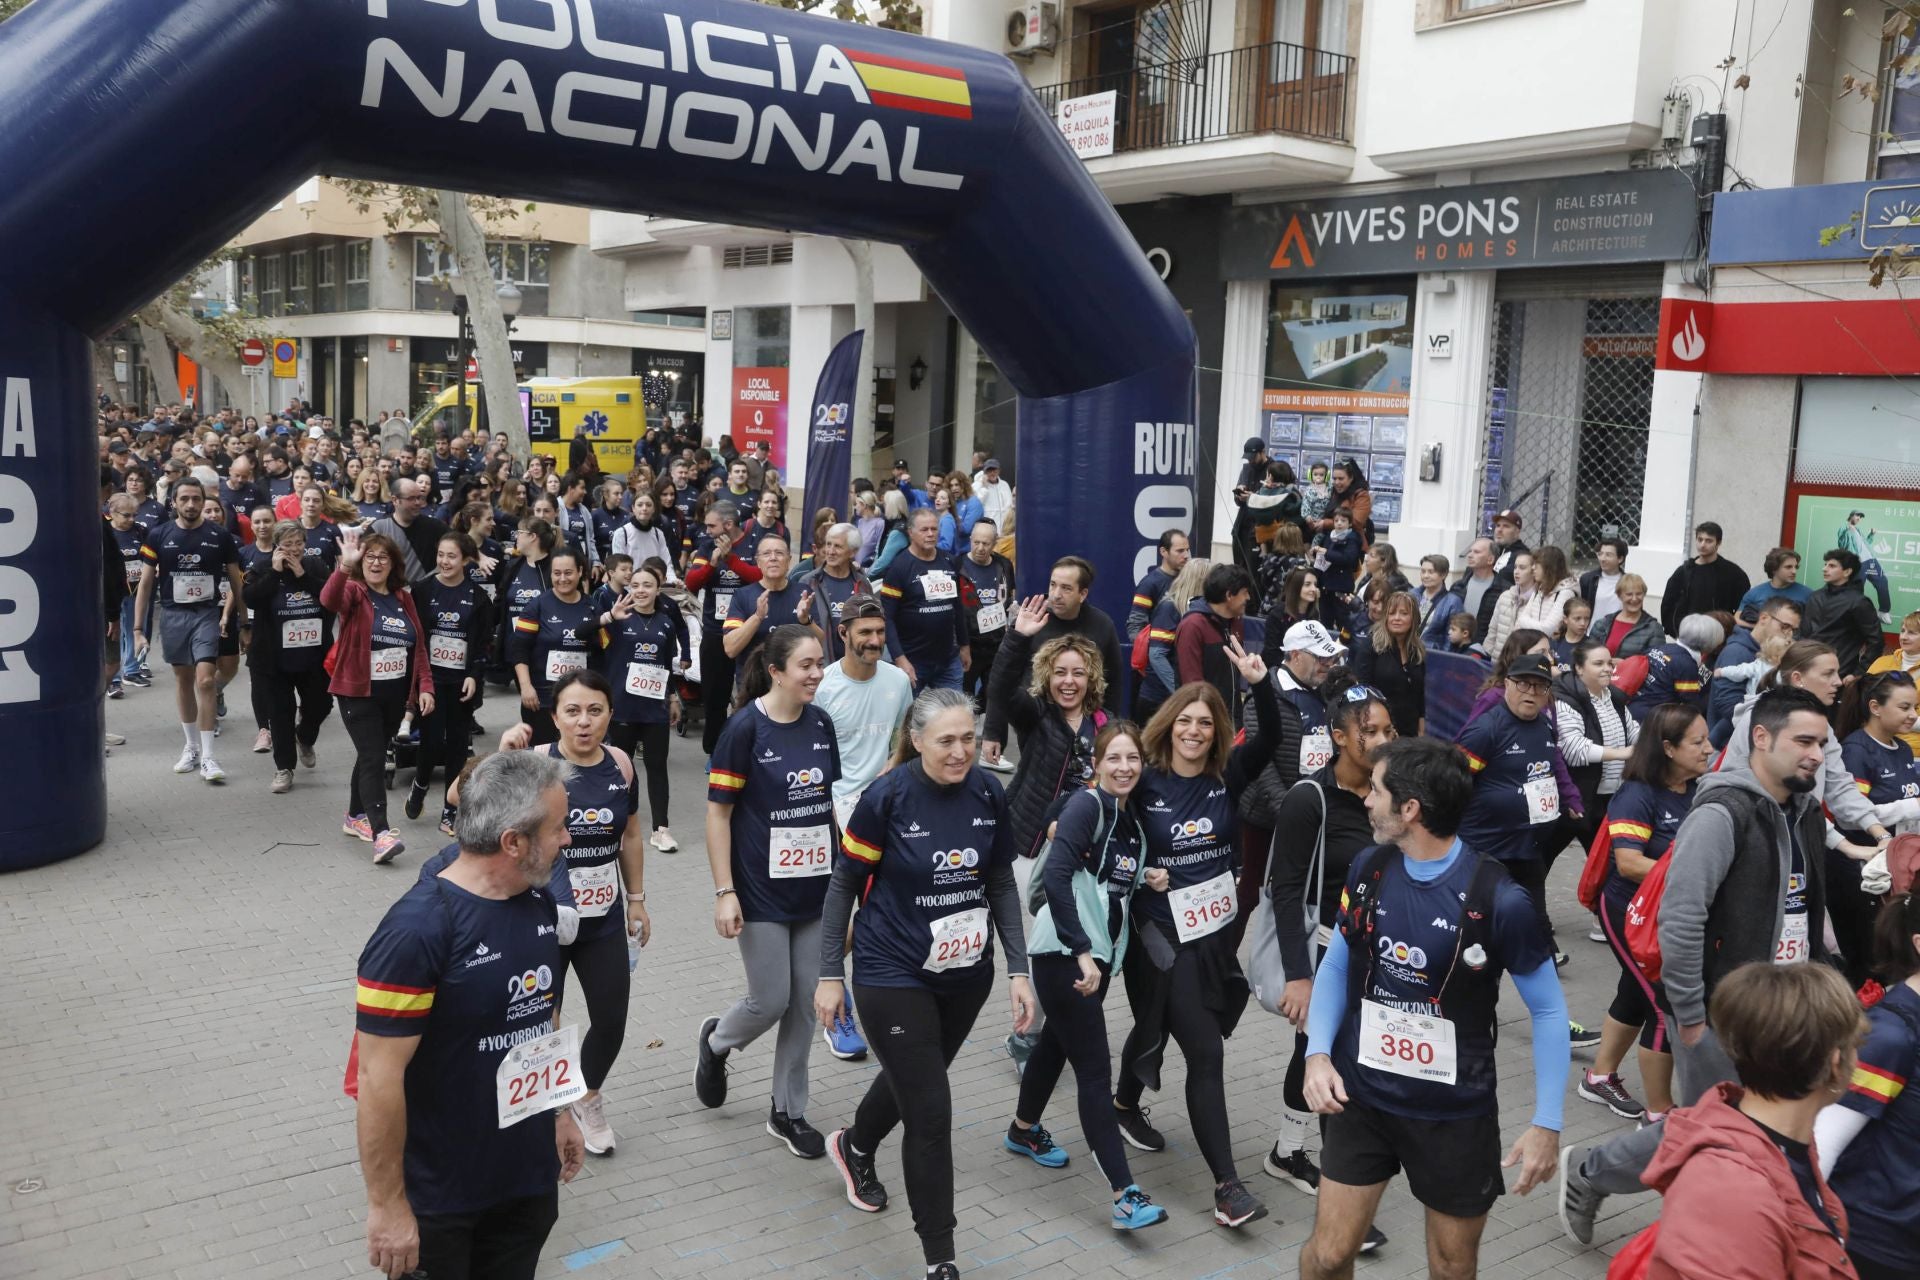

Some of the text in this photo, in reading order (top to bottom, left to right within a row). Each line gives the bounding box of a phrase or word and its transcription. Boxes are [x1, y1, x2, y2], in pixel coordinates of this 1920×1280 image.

[360, 37, 964, 190] NACIONAL
[1063, 116, 1109, 134] SE ALQUILA
[1078, 136, 1093, 150] 890
[1094, 132, 1109, 147] 086
[1555, 191, 1639, 210] REAL ESTATE
[1311, 196, 1520, 248] VIVES PONS
[1553, 211, 1653, 233] CONSTRUCTION
[1416, 239, 1518, 261] HOMES
[1551, 234, 1648, 253] ARCHITECTURE
[1429, 335, 1449, 348] VP
[748, 378, 770, 389] LOCAL
[740, 390, 780, 401] DISPONIBLE
[1265, 394, 1410, 409] ESTUDIO DE ARQUITECTURA Y CONSTRUCCIÓN
[610, 445, 632, 455] HCB
[1134, 422, 1194, 476] RUTA
[186, 587, 202, 597] 43
[516, 589, 541, 598] 200
[928, 582, 953, 593] 2439
[437, 612, 461, 622] 200
[288, 630, 318, 642] 2179
[432, 647, 464, 662] 2034
[634, 642, 658, 653] 200
[375, 659, 404, 673] 2035
[631, 676, 662, 692] 2079
[786, 767, 824, 789] 200
[1526, 761, 1551, 777] 200
[788, 791, 825, 801] NACIONAL
[569, 807, 614, 825] 200
[901, 830, 930, 838] Santander
[1170, 817, 1214, 841] 200
[779, 846, 826, 867] 2215
[932, 847, 979, 871] 200
[1115, 853, 1137, 872] 200
[933, 871, 970, 880] POLICIA
[933, 876, 979, 885] NACIONAL
[570, 885, 614, 906] 2259
[1184, 896, 1232, 928] 3163
[937, 931, 982, 962] 2214
[1378, 936, 1428, 969] 200
[465, 951, 502, 968] Santander
[1379, 959, 1418, 978] POLICIA
[508, 964, 553, 1004] 200
[506, 1001, 553, 1022] NACIONAL
[507, 995, 546, 1013] POLICIA
[1381, 1033, 1434, 1065] 380
[509, 1059, 571, 1106] 2212
